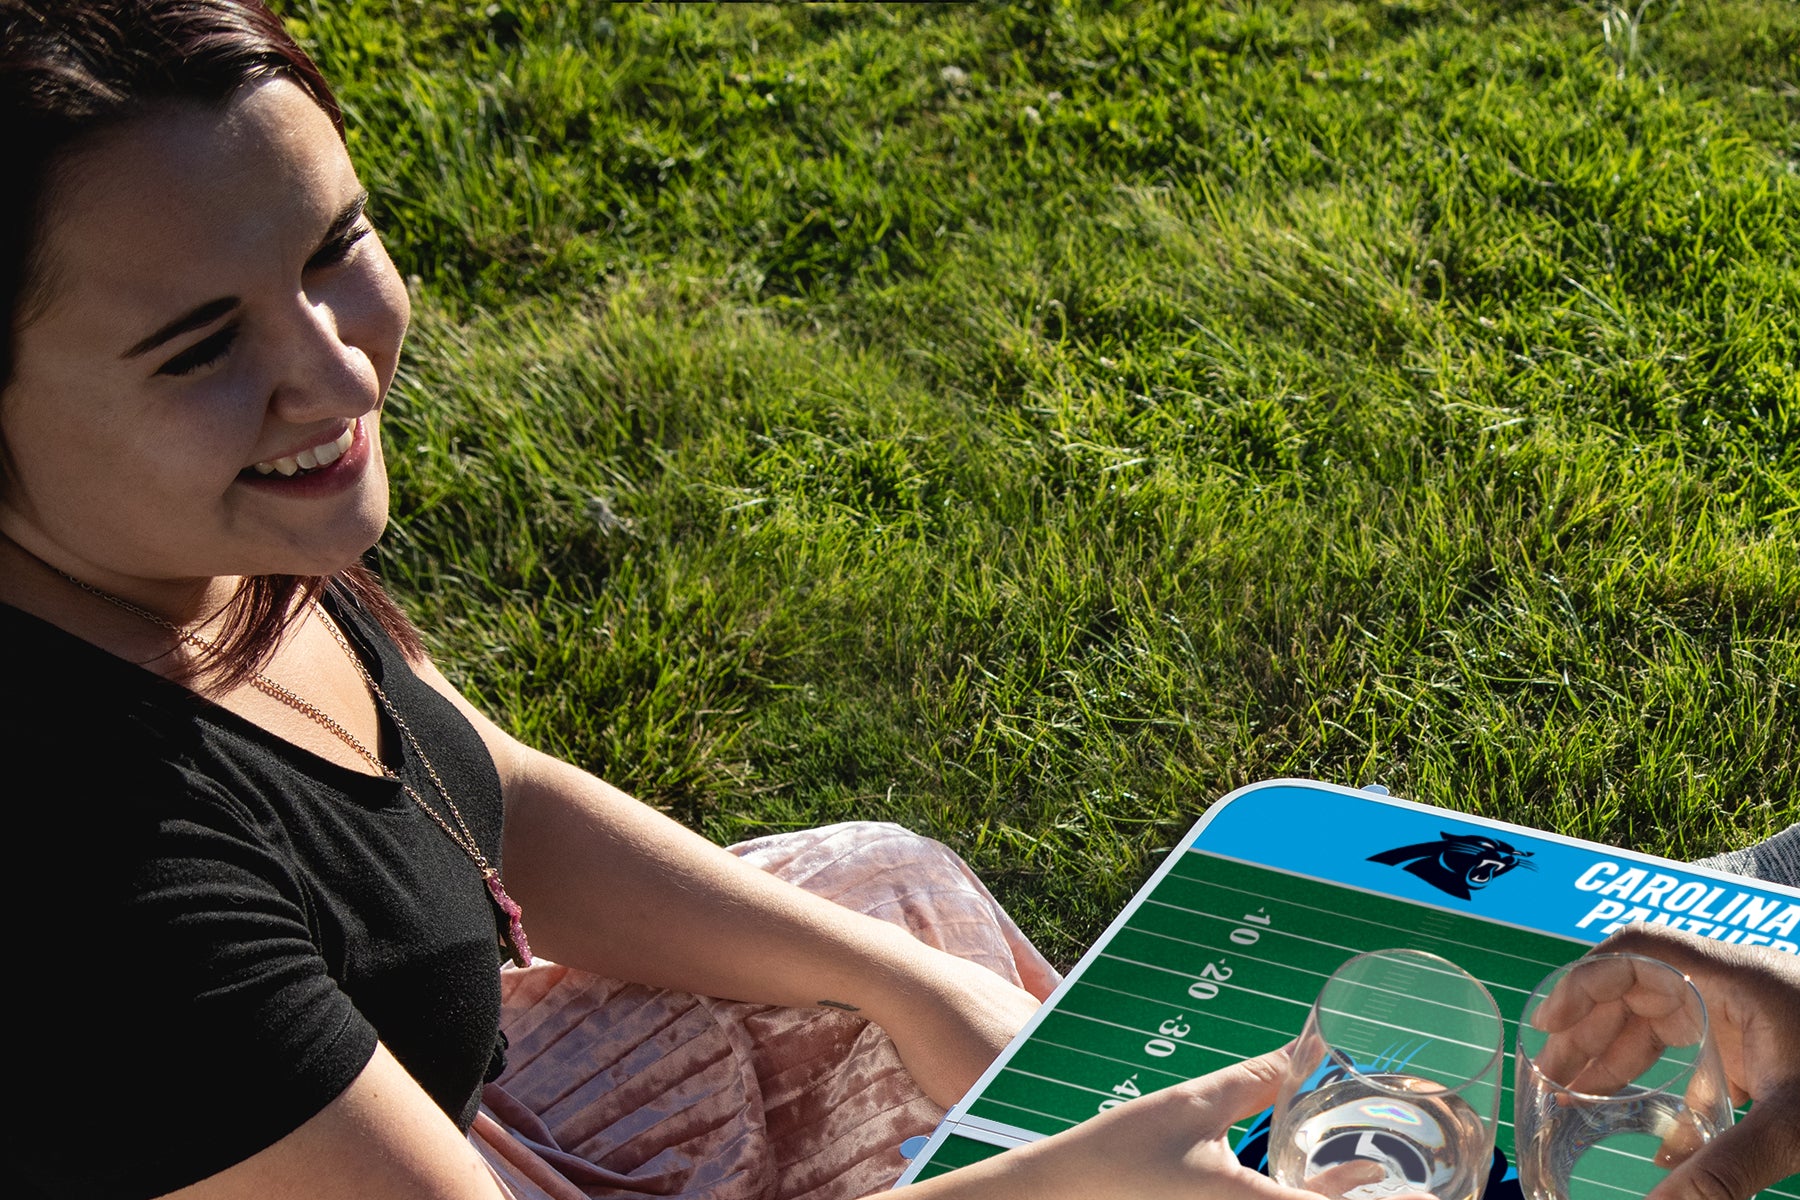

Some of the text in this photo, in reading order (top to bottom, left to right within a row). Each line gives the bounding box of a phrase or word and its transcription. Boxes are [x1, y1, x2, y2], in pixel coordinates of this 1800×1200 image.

[1229, 914, 1272, 945] 10
[1188, 962, 1234, 1000] 20
[1144, 1018, 1191, 1058] 30
